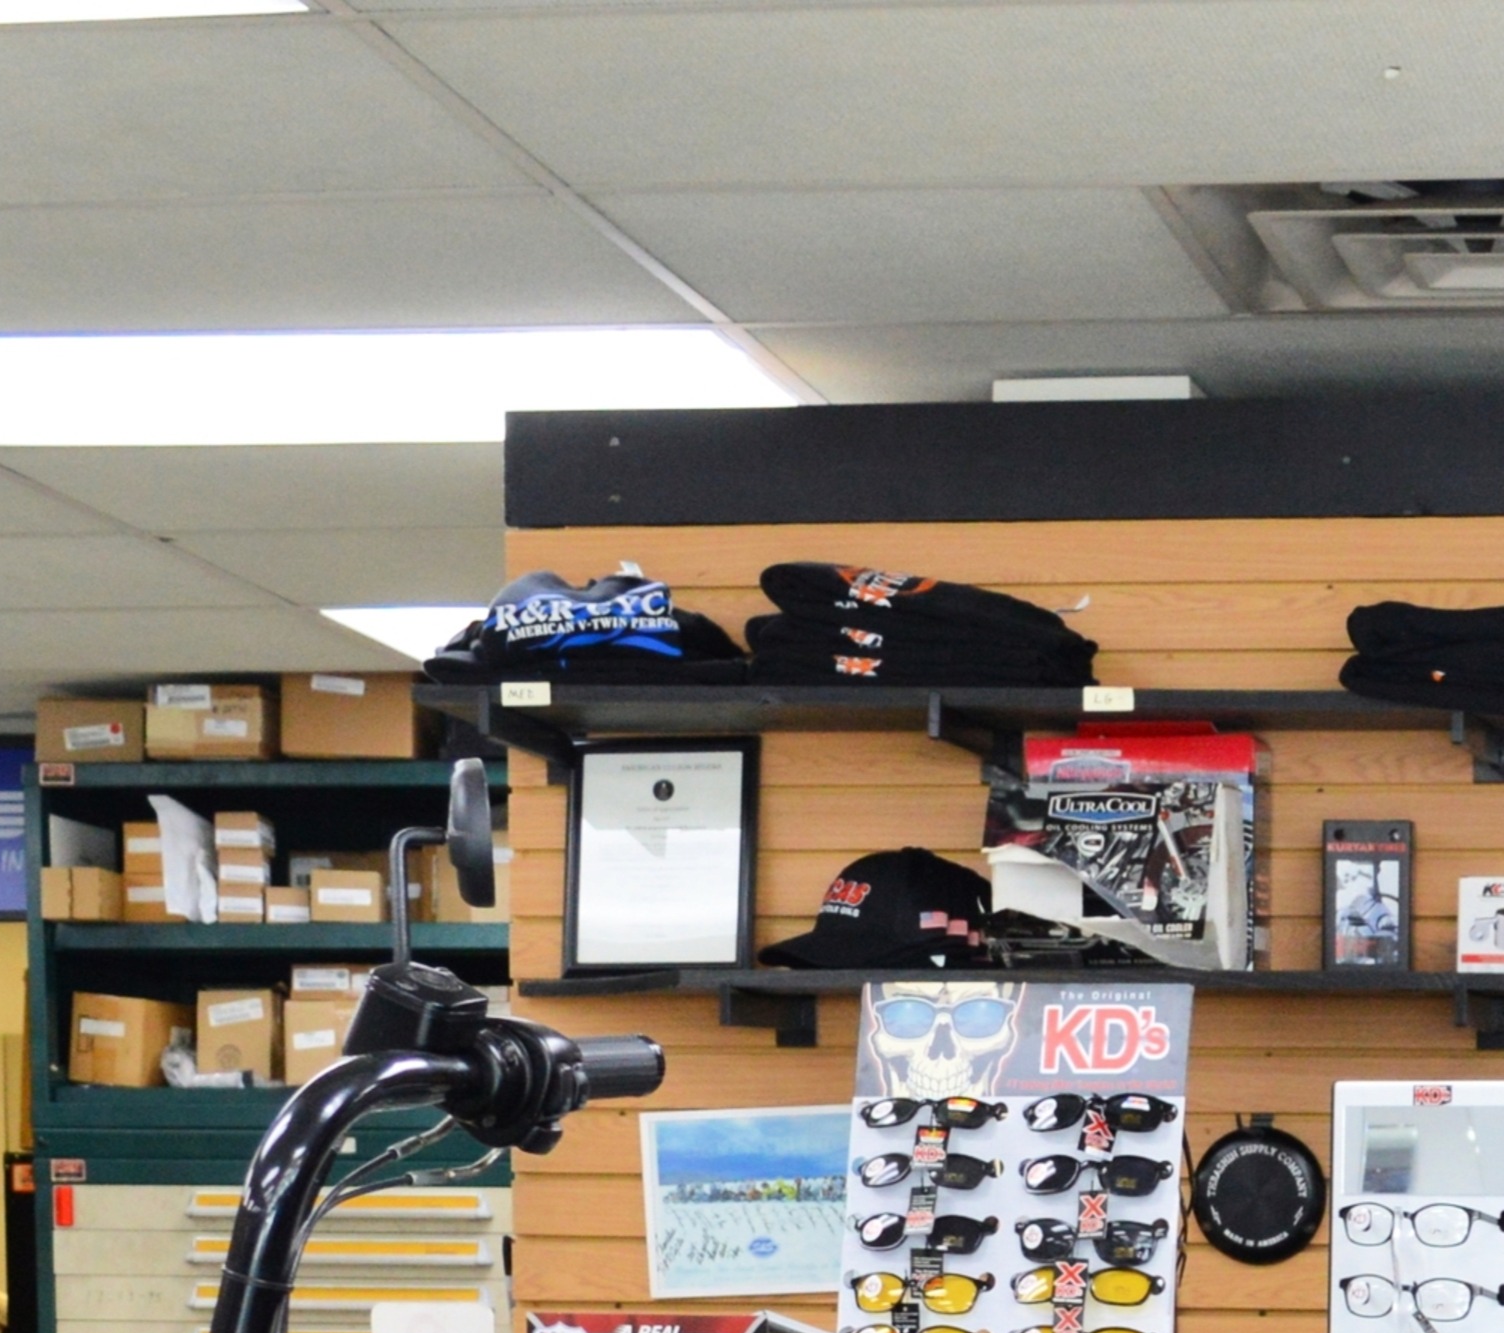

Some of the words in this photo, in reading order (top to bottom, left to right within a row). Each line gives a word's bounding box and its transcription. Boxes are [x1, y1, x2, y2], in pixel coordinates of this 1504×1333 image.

[495, 599, 575, 632] R&R
[507, 622, 575, 643] AMERICAN
[579, 617, 628, 632] V-TWIN
[1065, 823, 1109, 832] COOLING
[1111, 823, 1154, 832] SYSTEMS
[1165, 922, 1194, 934] COOLER
[1059, 990, 1085, 1000] The
[1091, 990, 1152, 1001] Original
[1040, 1003, 1170, 1074] KD's
[1239, 1143, 1278, 1157] SUPPLY
[1277, 1151, 1308, 1198] COMPANY
